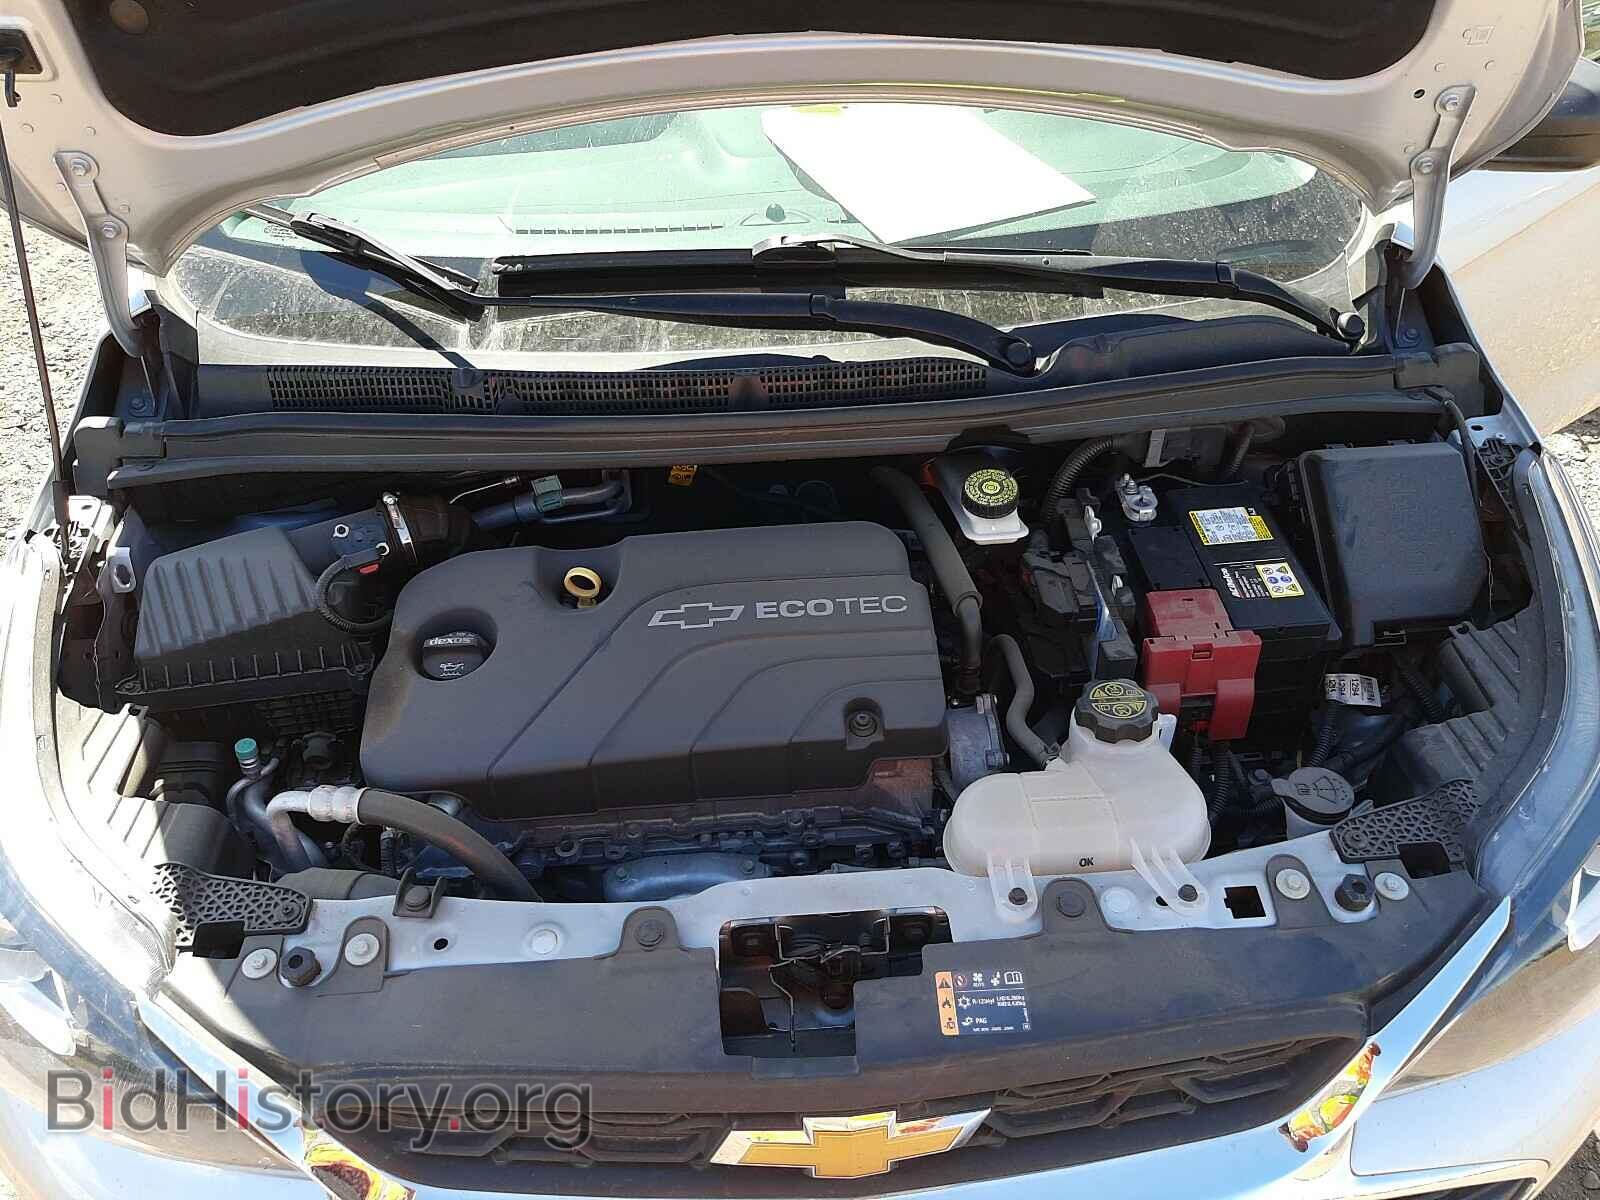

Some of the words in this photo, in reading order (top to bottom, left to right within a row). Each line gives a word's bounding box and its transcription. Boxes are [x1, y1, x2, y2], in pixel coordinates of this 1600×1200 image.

[756, 595, 908, 619] ECOTEC
[429, 637, 472, 646] dexos
[1079, 857, 1094, 867] OK
